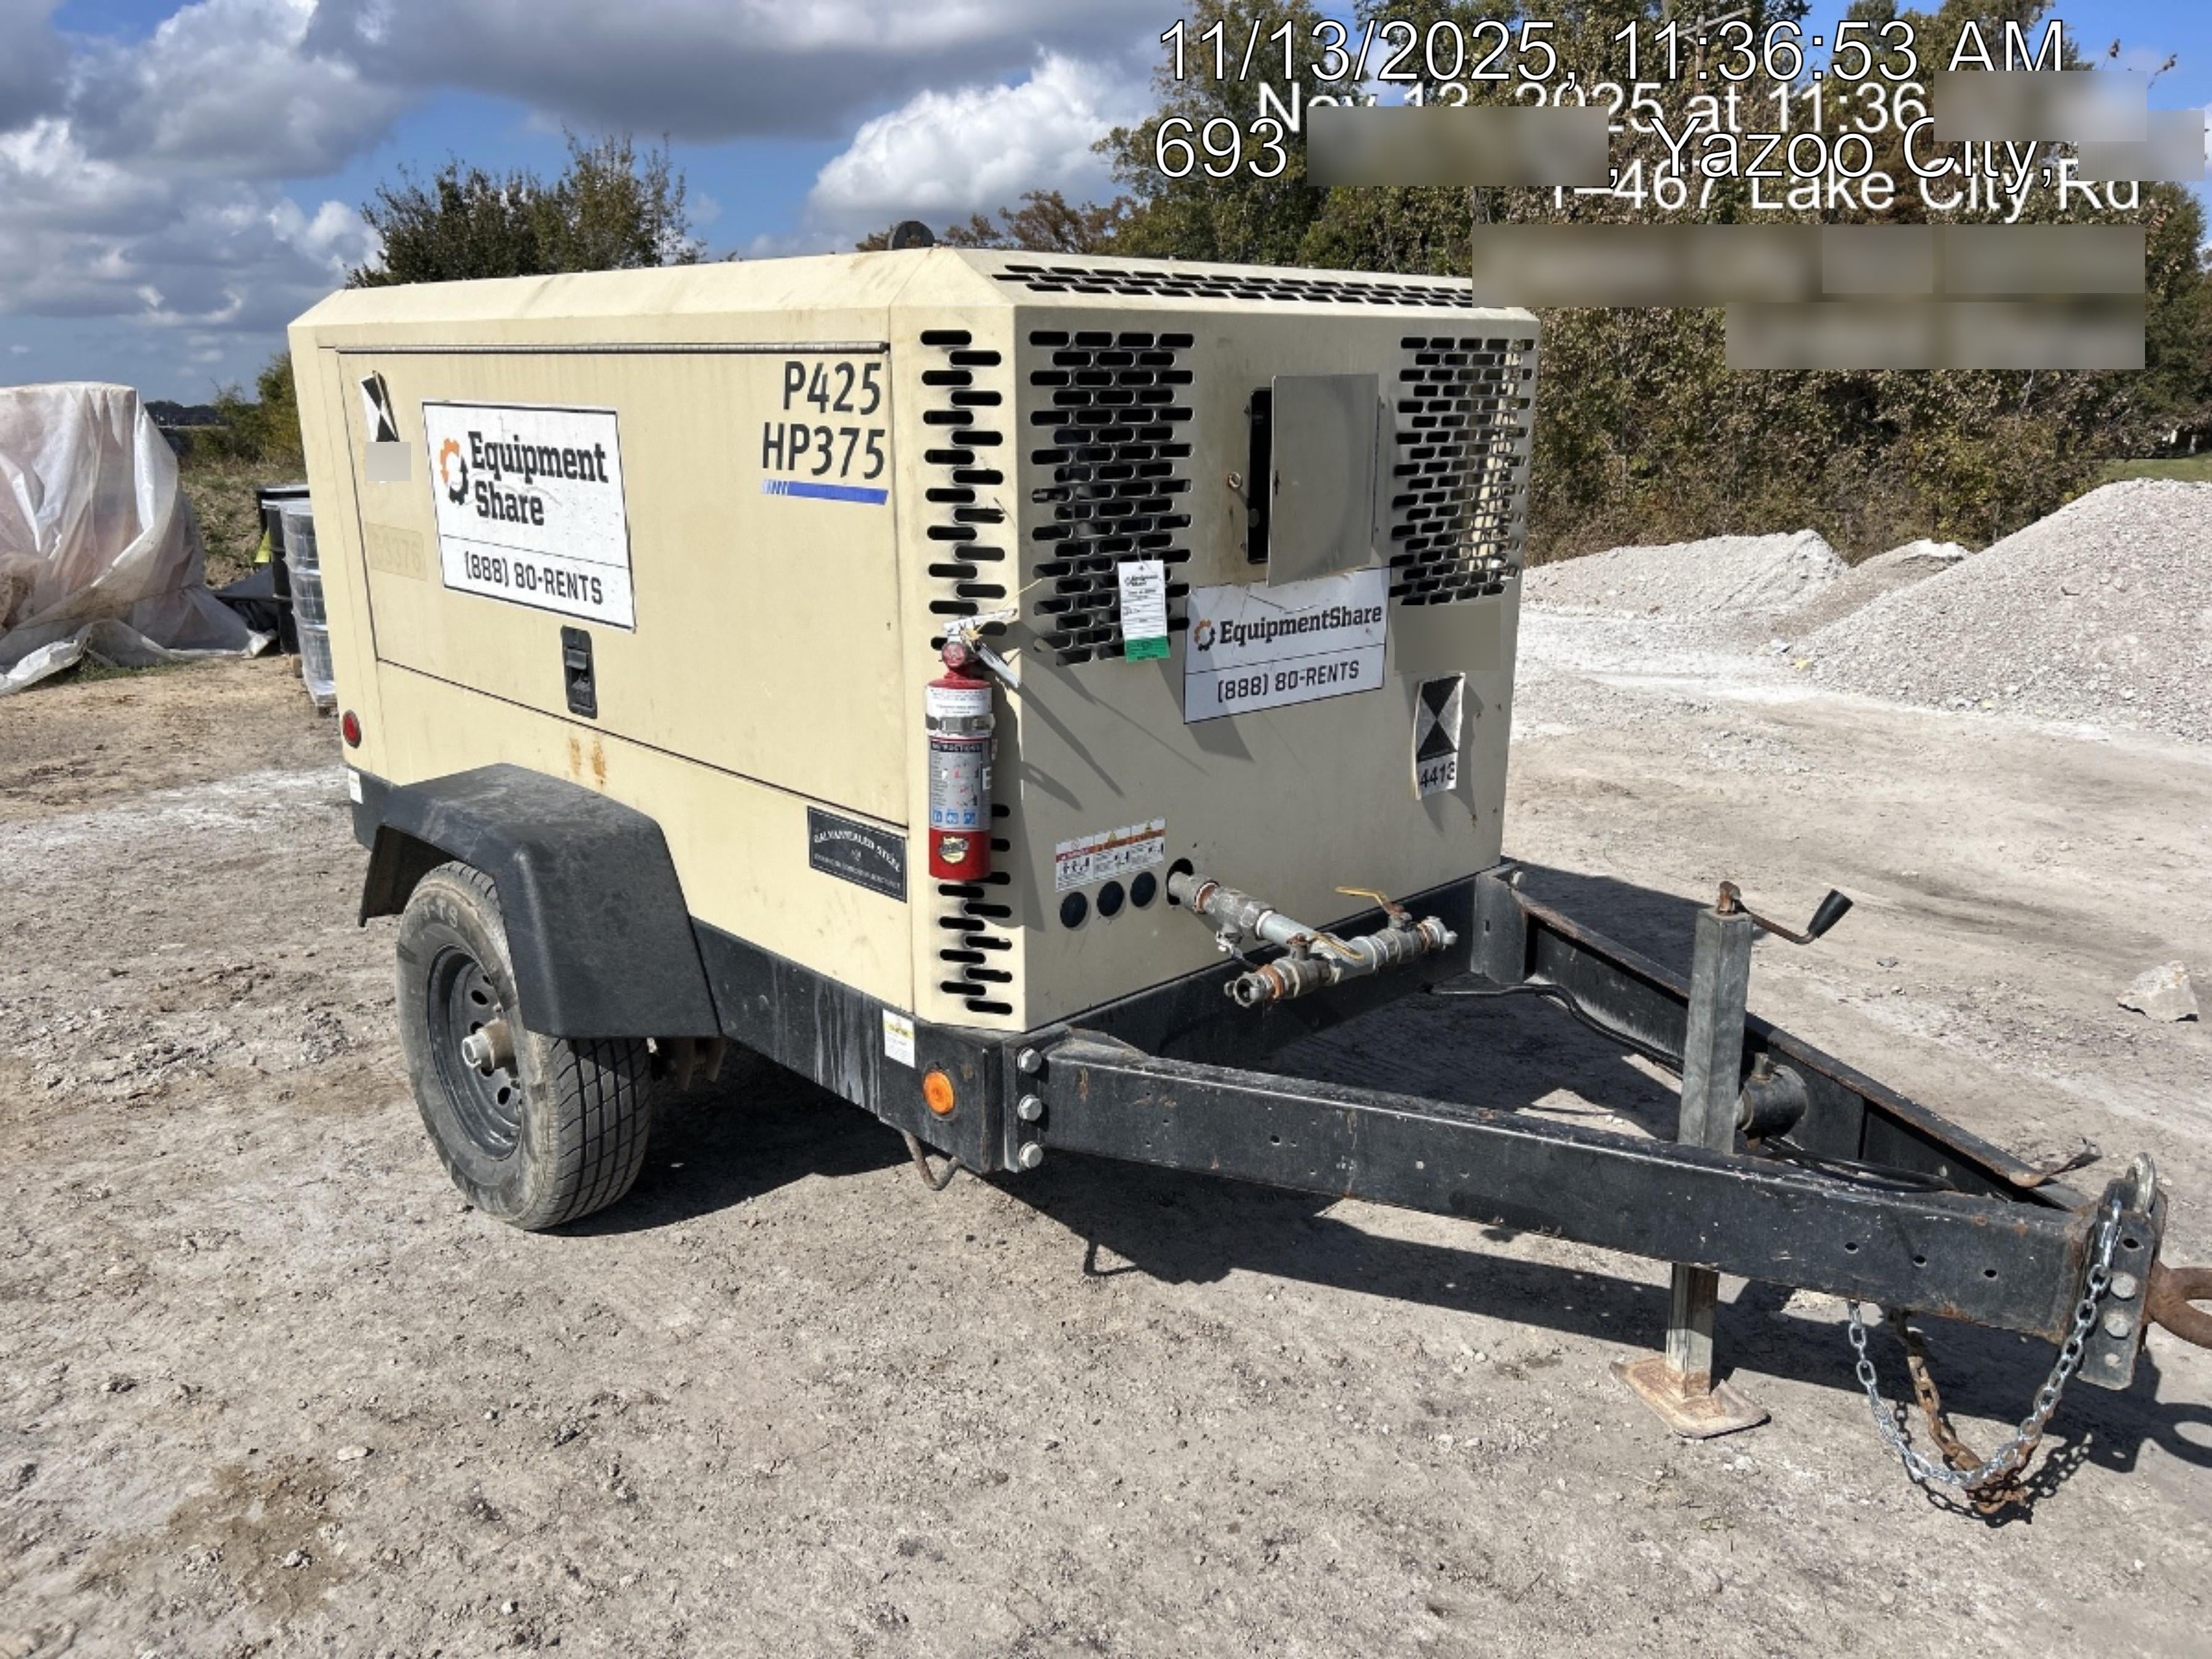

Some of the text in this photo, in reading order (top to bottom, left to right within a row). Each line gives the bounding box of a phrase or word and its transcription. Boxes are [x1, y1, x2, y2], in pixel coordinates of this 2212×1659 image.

[783, 360, 882, 415] P425
[468, 430, 609, 484] Equipment
[763, 421, 886, 480] HP375
[474, 479, 545, 526] Share
[465, 550, 509, 588] (888)
[514, 561, 604, 605] 80-RENTS
[1219, 605, 1382, 647] EquipmentShare
[1217, 660, 1360, 704] (888) 80-RENTS
